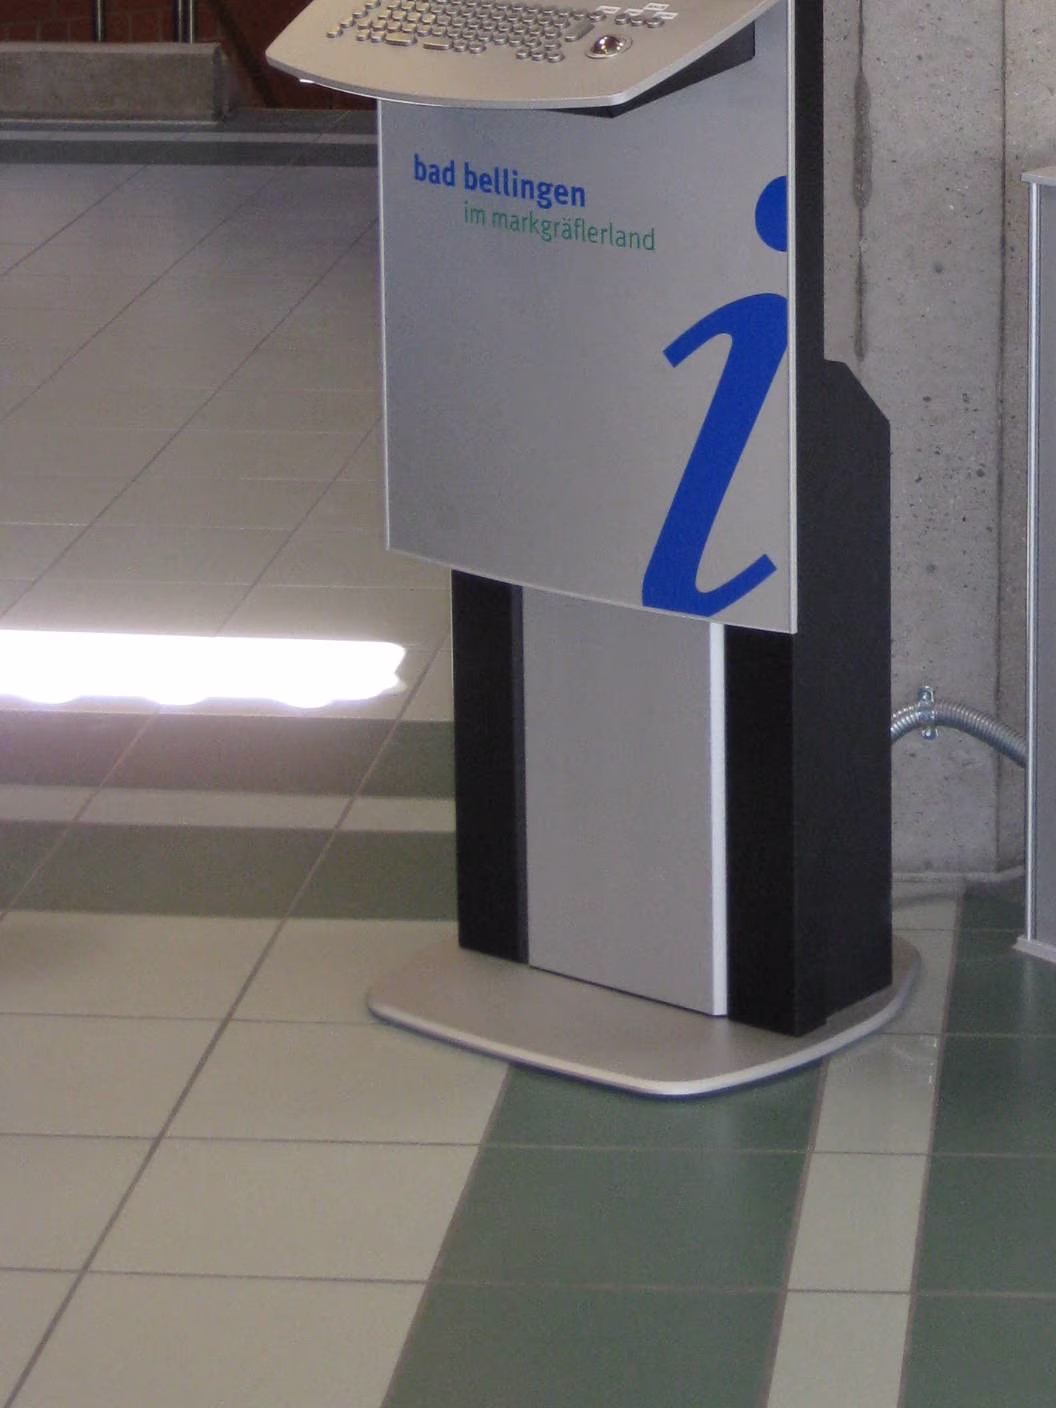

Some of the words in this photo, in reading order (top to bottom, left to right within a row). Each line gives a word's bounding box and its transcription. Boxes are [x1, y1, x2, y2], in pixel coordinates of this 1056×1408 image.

[413, 153, 456, 187] bad
[464, 162, 586, 210] bellingen
[464, 200, 485, 225] im
[492, 210, 656, 251] markgräflerland
